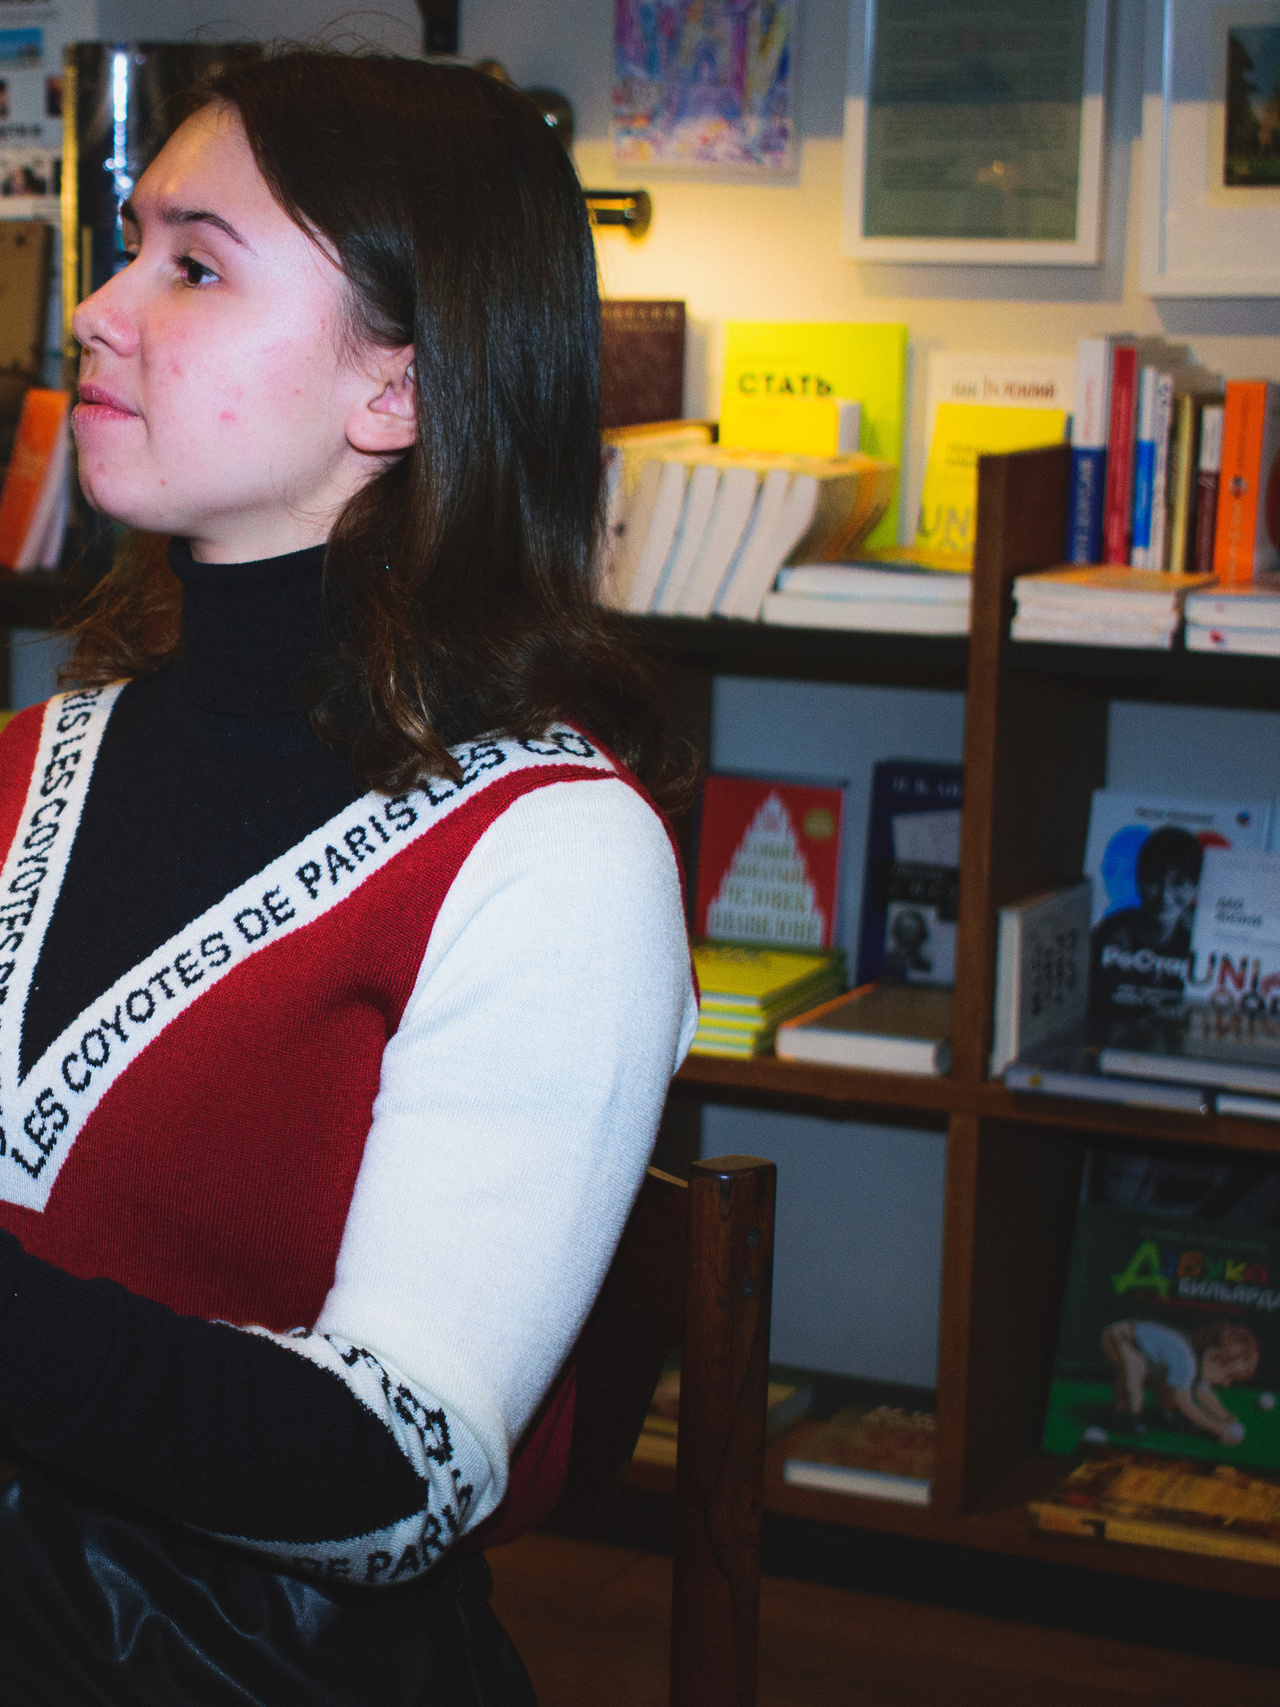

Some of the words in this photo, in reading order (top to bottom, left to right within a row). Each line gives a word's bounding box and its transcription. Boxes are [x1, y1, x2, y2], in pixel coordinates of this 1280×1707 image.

[738, 372, 833, 397] СТАТЬ
[39, 732, 87, 797] LES
[9, 1087, 70, 1179] LES
[61, 929, 233, 1094] COYOTES
[234, 883, 298, 945] DE
[295, 792, 420, 901] PARIS
[422, 740, 507, 807] LES
